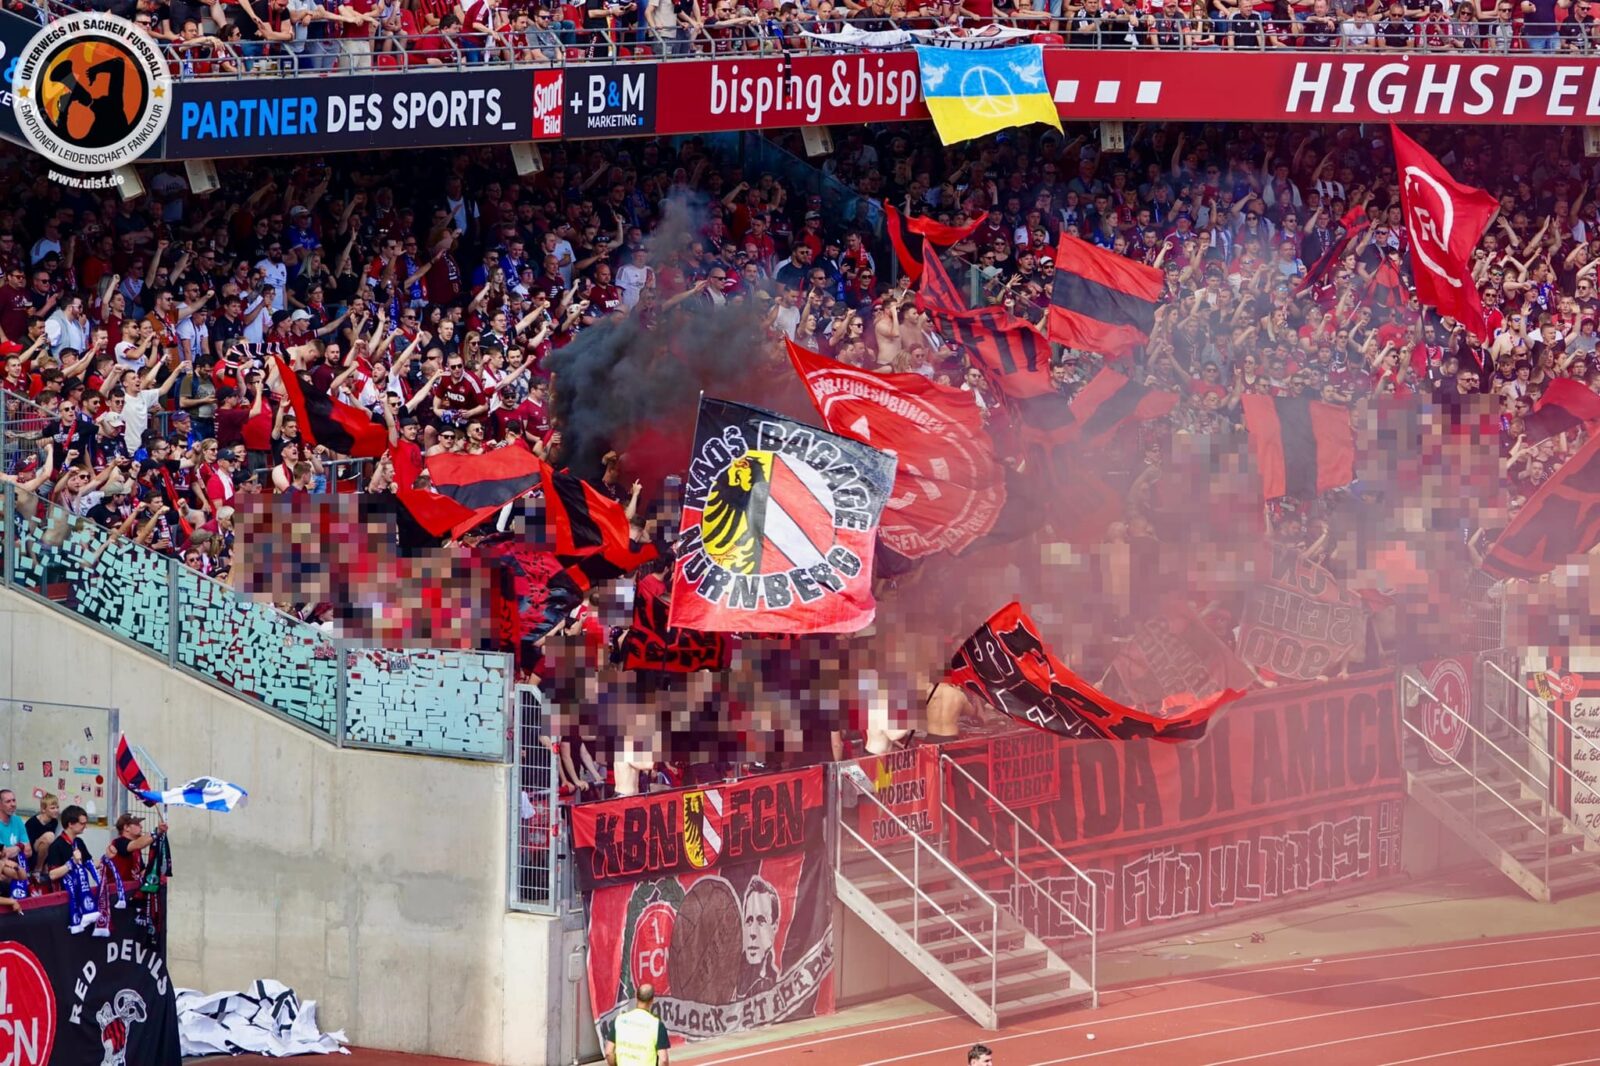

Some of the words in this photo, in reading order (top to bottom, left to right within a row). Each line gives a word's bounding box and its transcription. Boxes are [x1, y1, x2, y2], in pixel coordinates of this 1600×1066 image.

[533, 73, 563, 120] Sport
[588, 73, 645, 113] B&M
[710, 63, 823, 125] bisping
[828, 59, 852, 107] &
[181, 97, 318, 140] PARTNER
[327, 94, 382, 134] DES
[543, 115, 561, 134] Bild
[684, 425, 749, 512] KAOS
[757, 421, 873, 532] BAGAGE
[675, 524, 862, 611] NÜRNBERG
[1573, 703, 1586, 718] Es
[993, 752, 1053, 782] STADION
[994, 733, 1053, 759] SEKTION
[1250, 688, 1402, 806] AMICI
[1573, 749, 1587, 761] die
[996, 774, 1052, 801] VERBOT
[592, 800, 679, 879] KBN
[725, 778, 806, 857] FCN
[1123, 844, 1201, 925] FÜR
[1209, 816, 1372, 908] ULTRAS!
[651, 917, 665, 944] 1.
[69, 960, 97, 1024] RED
[107, 939, 168, 996] DEVILS
